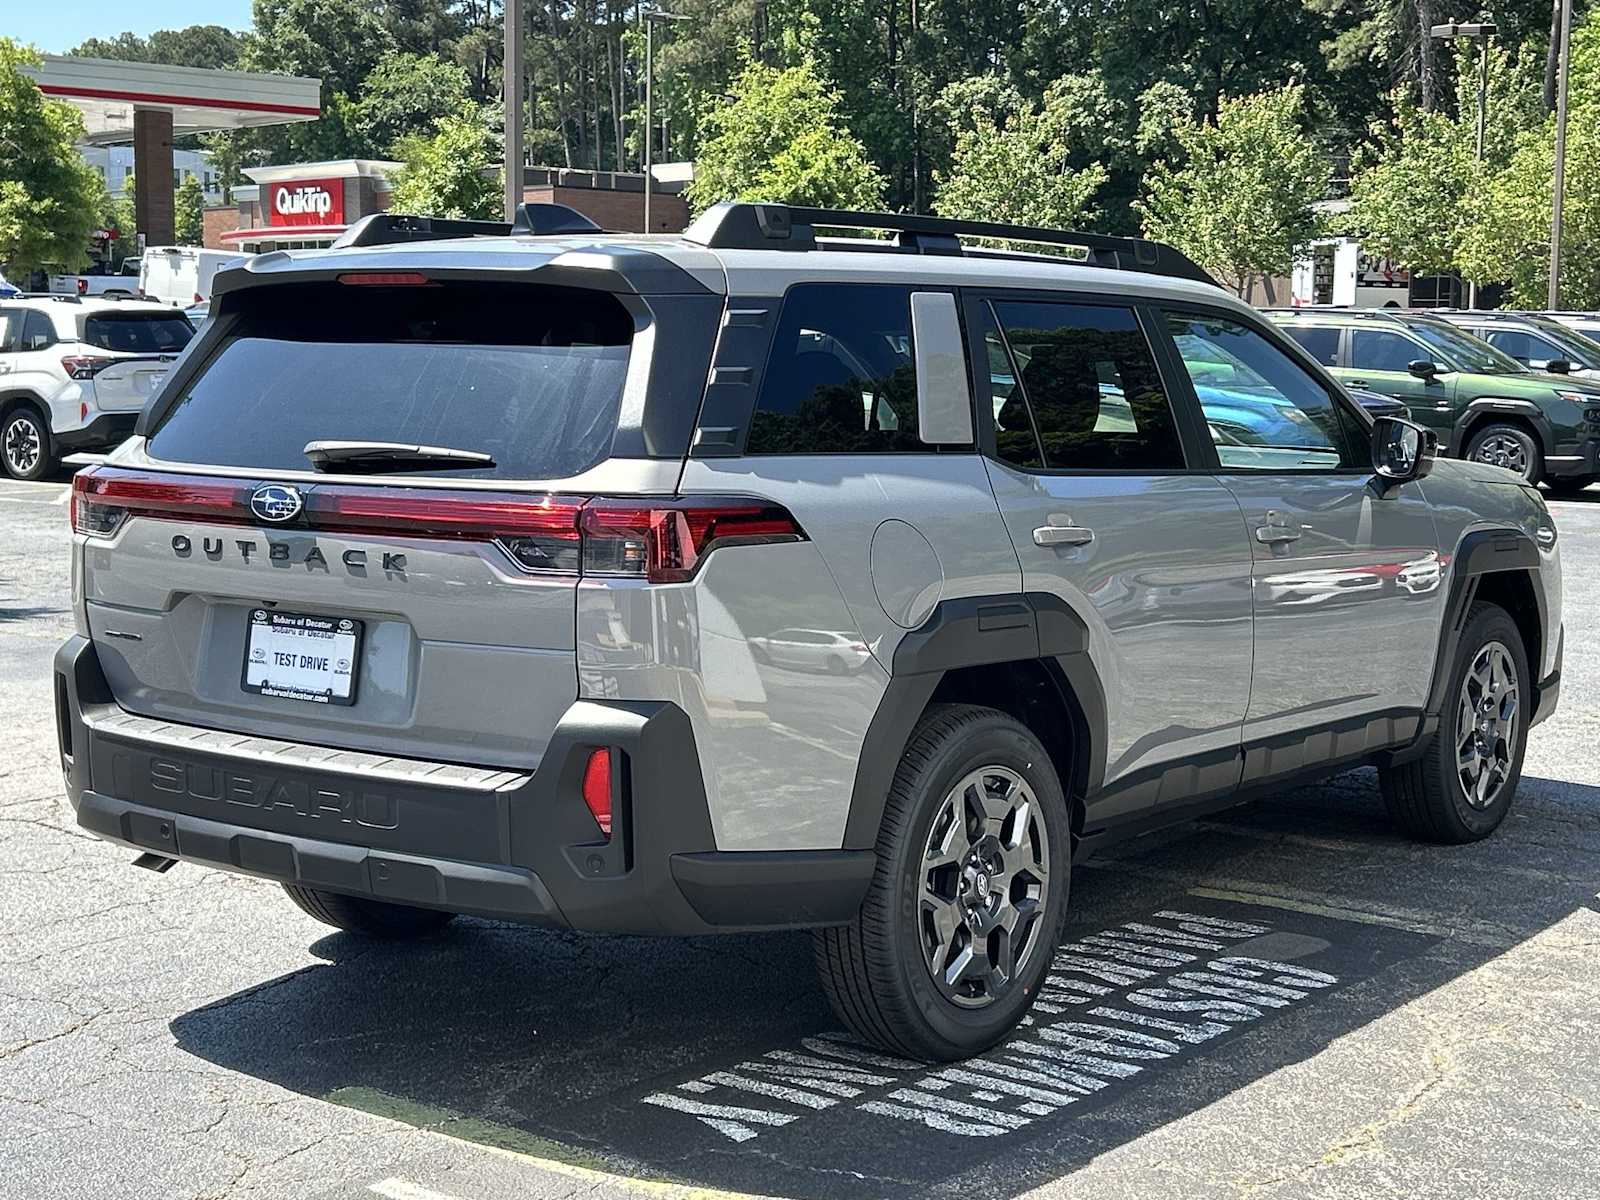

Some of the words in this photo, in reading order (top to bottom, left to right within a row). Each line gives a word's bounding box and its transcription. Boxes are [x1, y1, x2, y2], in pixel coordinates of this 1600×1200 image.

[276, 187, 331, 218] QuikTrip
[171, 534, 408, 573] OUTBACK
[272, 614, 296, 626] Subaru
[297, 618, 305, 626] of
[305, 618, 333, 630] Decatur
[274, 652, 298, 668] TEST
[300, 655, 329, 672] DRIVE
[151, 759, 399, 830] SUBARU
[856, 956, 1339, 1137] CUSTOMER
